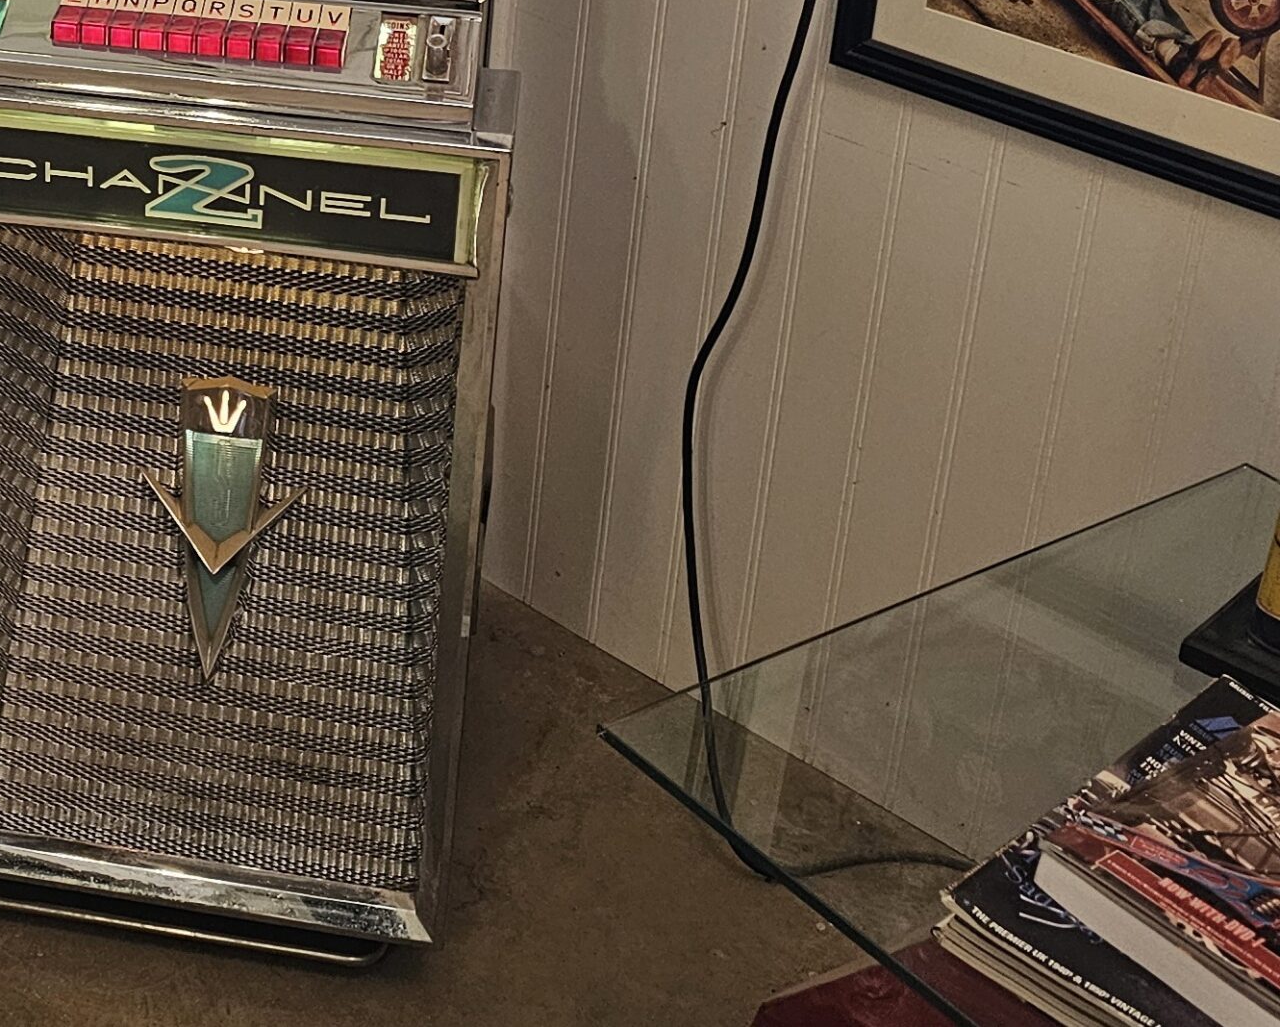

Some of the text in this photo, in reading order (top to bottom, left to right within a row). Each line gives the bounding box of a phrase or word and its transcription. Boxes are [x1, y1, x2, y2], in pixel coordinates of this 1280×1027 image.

[209, 1, 226, 15] R
[240, 4, 255, 18] S
[270, 6, 284, 21] T
[297, 8, 313, 23] U
[328, 11, 342, 26] V
[1229, 681, 1254, 701] MUSIC
[971, 905, 990, 923] THE
[989, 920, 1033, 953] PREMIER
[1032, 948, 1048, 963] UK
[1110, 995, 1155, 1027] VINTAGE
